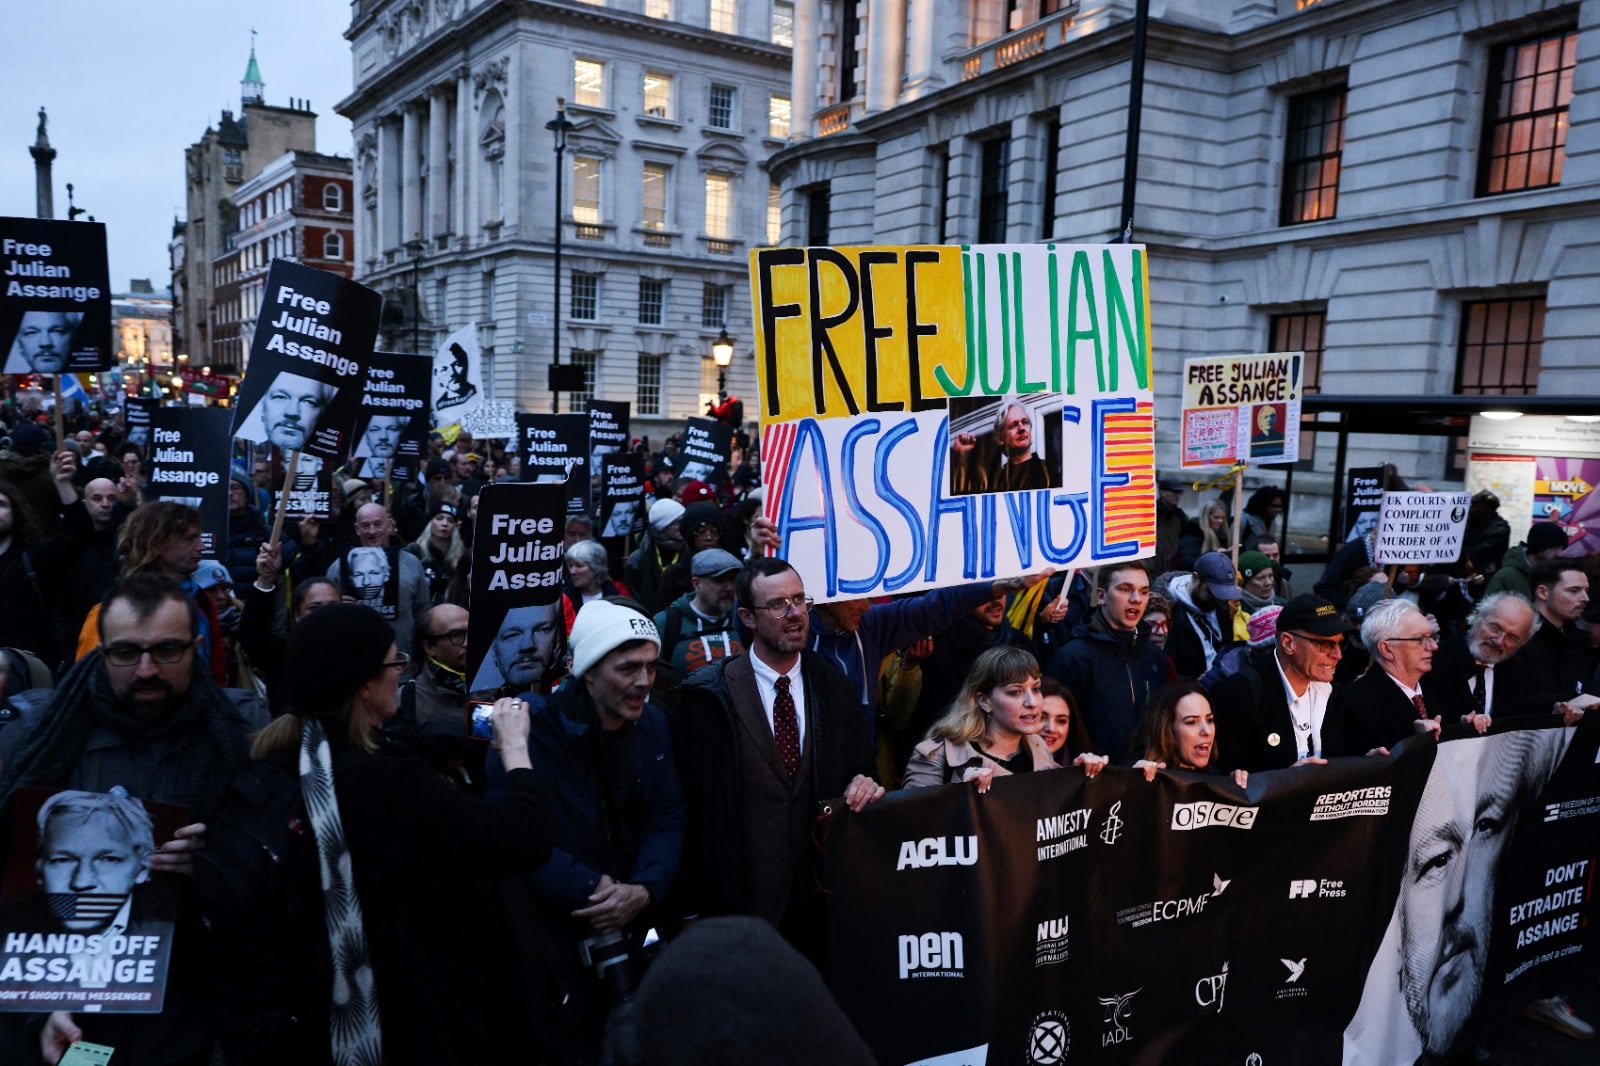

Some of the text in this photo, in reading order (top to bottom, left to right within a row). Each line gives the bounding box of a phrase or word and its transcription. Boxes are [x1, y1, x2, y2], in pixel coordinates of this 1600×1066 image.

[3, 238, 52, 258] Free
[4, 260, 71, 279] Julian
[6, 281, 100, 302] Assange
[276, 286, 332, 316] Free
[271, 311, 343, 346] Julian
[757, 248, 948, 417] FREE
[266, 334, 359, 376] Assange
[368, 366, 395, 379] ree
[1189, 359, 1289, 384] FREE JULIAN
[363, 380, 405, 394] Julian
[361, 394, 424, 410] Assange
[590, 409, 613, 420] Free
[527, 427, 556, 438] Free
[590, 420, 619, 430] Julian
[688, 426, 709, 438] Free
[153, 428, 181, 443] Free
[686, 436, 715, 449] Julian
[153, 447, 194, 463] Julian
[527, 441, 568, 453] Julian
[684, 446, 724, 463] Assange
[152, 467, 219, 486] Assange
[607, 464, 630, 474] Free
[607, 476, 637, 485] Julian
[1353, 477, 1378, 486] Free
[1550, 482, 1586, 493] MOVE
[1387, 495, 1470, 506] UK COURTS ARE
[1385, 508, 1443, 519] COMPLICIT
[490, 514, 554, 536] Free
[1382, 522, 1451, 533] IN THE SLOW
[1381, 535, 1458, 546] MURDER OF AN
[1379, 548, 1456, 560] INNOCENT MAN
[1315, 785, 1392, 806] REPORTERS
[1313, 798, 1390, 814] WITHOUT BORDERS
[1036, 808, 1092, 842] AMNESTY
[896, 835, 979, 871] ACLU
[1037, 834, 1088, 862] INTERNATIONAL
[1545, 860, 1589, 887] DON'T
[1289, 879, 1318, 899] FP
[1319, 879, 1344, 888] Free
[1319, 888, 1347, 898] Press
[1153, 893, 1211, 921] ECPMF
[1510, 886, 1584, 926] EXTRADITE
[1037, 914, 1069, 942] NUJ
[1517, 912, 1580, 950] ASSANGE
[5, 932, 160, 956] HANDS OFF
[898, 931, 964, 979] pen
[0, 957, 157, 984] ASSANGE
[1504, 959, 1534, 984] Journalism
[1541, 950, 1554, 962] not
[1560, 944, 1583, 957] crime
[912, 971, 965, 979] INTERNATIONAL
[28, 991, 66, 1000] SHOOT
[66, 991, 88, 1000] THE
[88, 991, 153, 1001] MESSENGER
[1101, 1027, 1134, 1048] IADL
